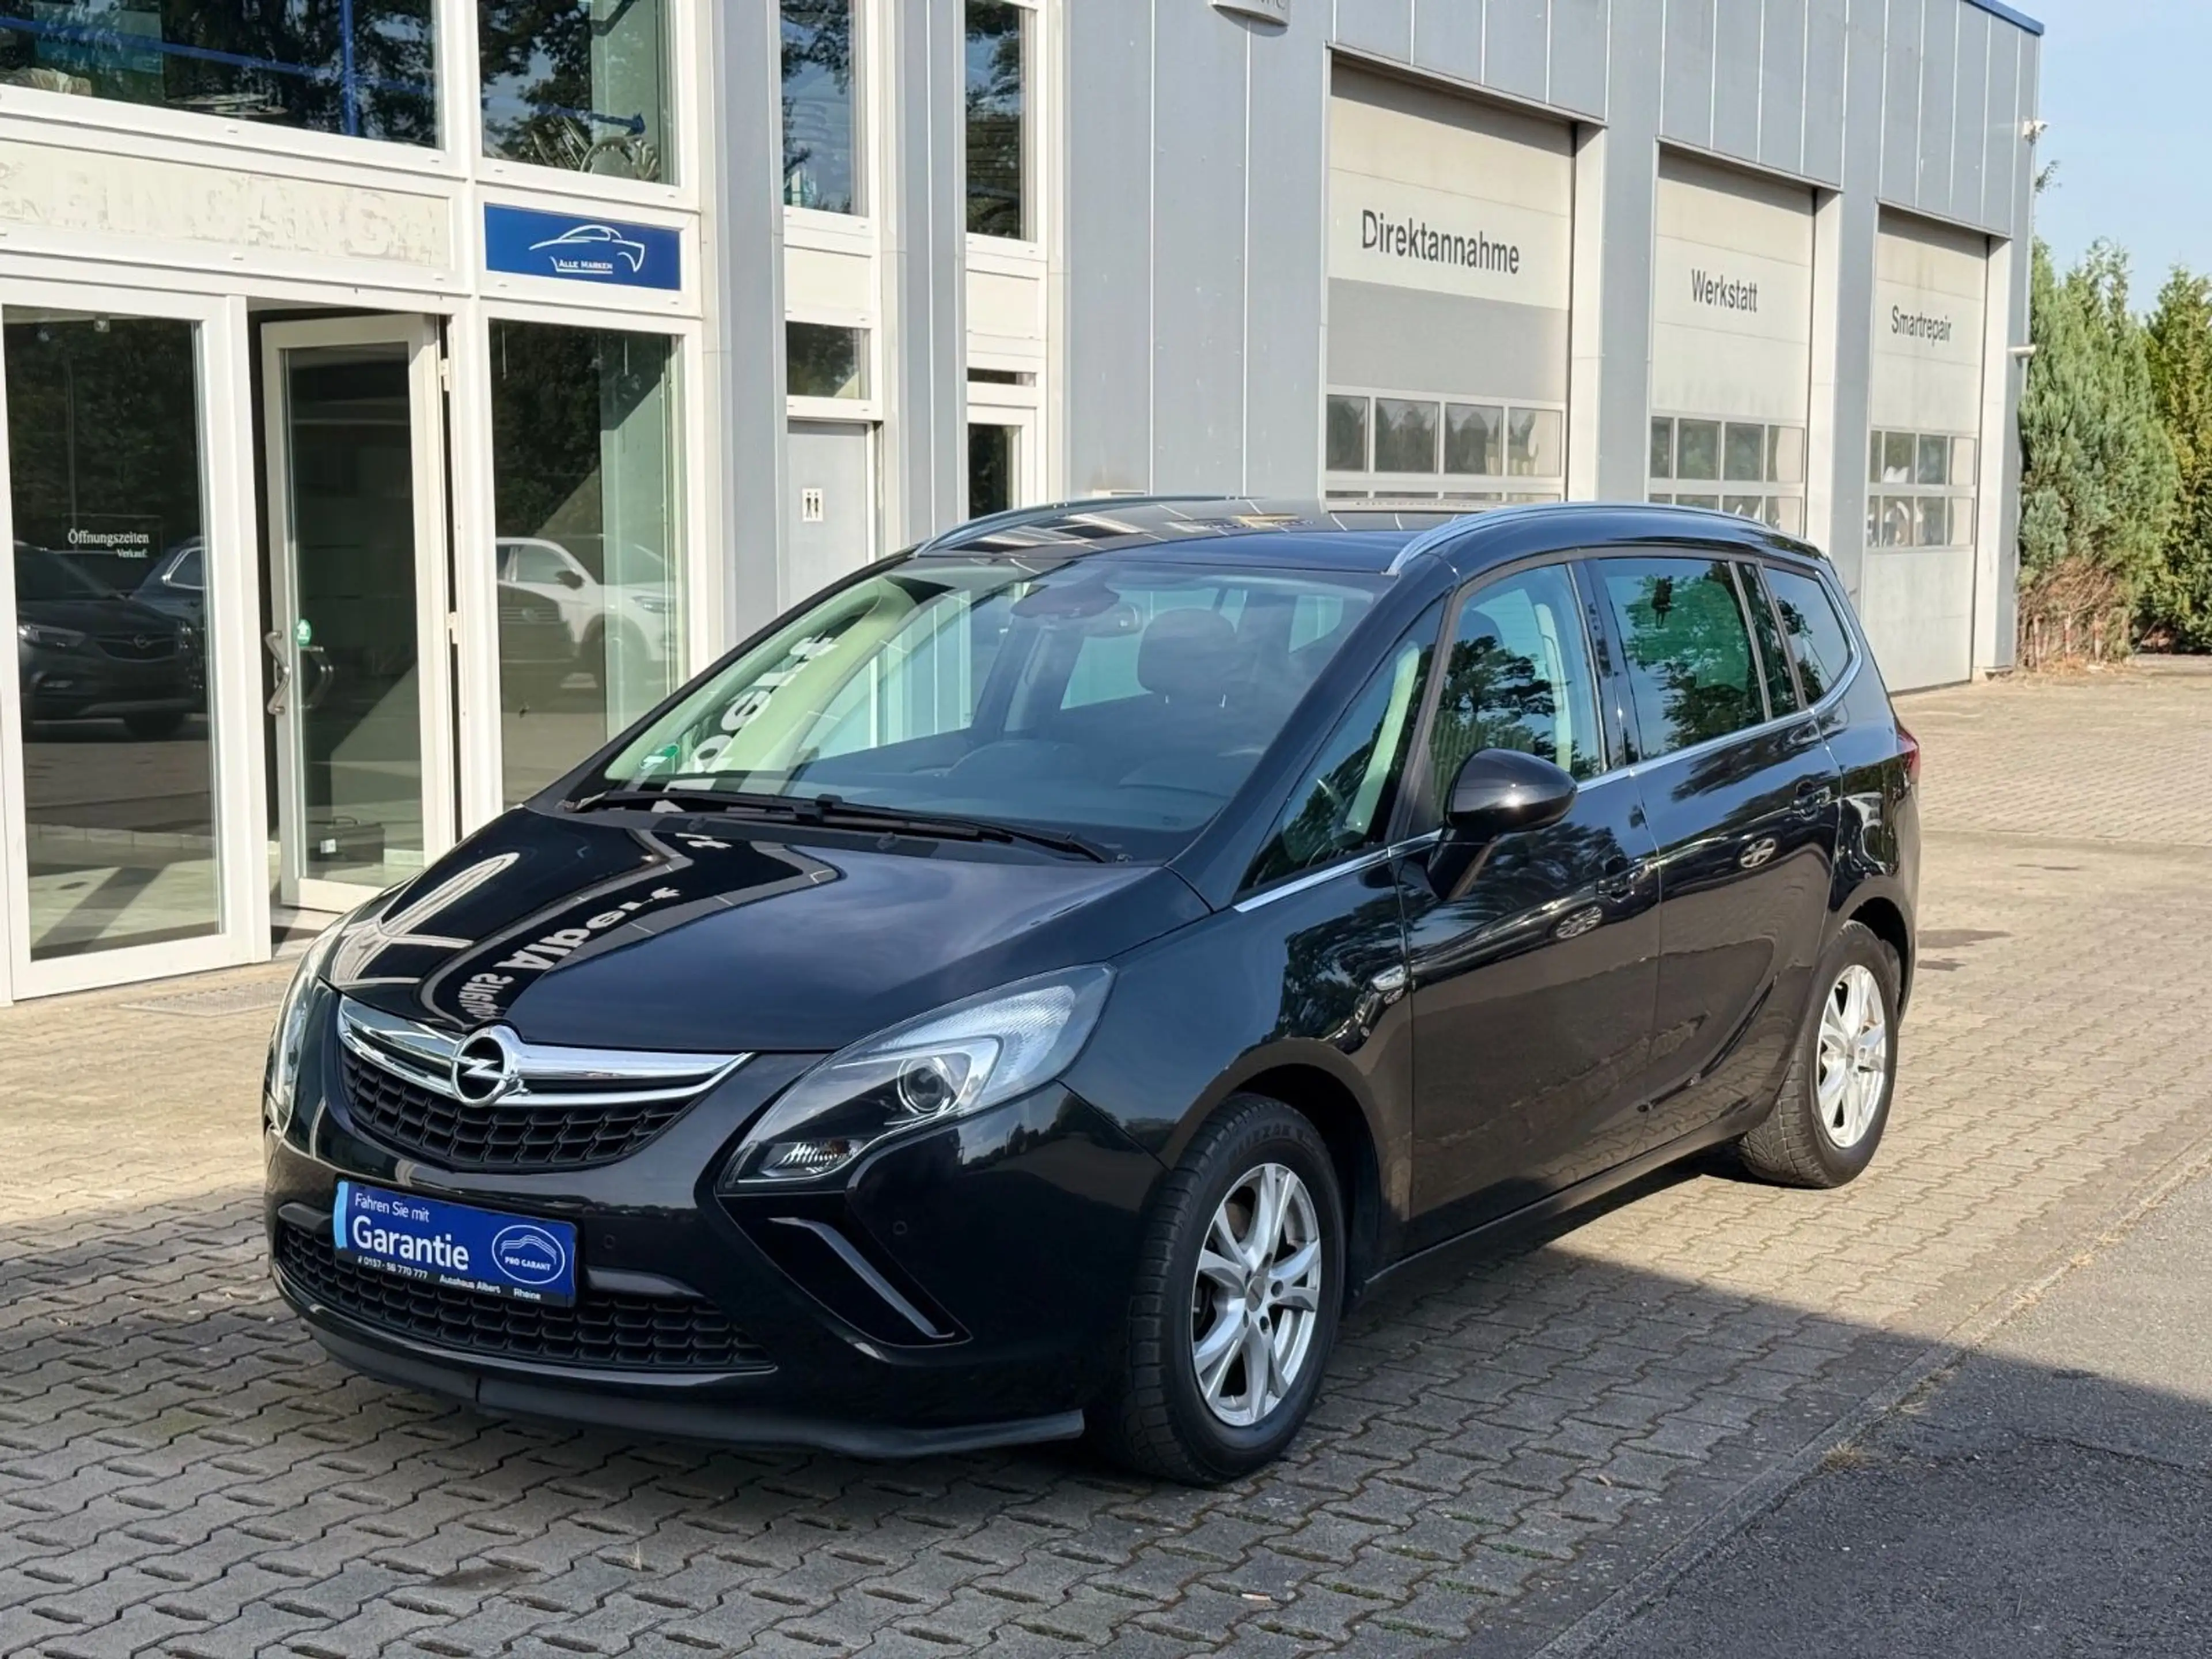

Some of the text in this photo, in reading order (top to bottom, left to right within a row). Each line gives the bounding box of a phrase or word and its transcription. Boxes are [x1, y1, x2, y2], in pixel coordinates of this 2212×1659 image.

[1362, 209, 1520, 274] Direktannahme
[558, 259, 613, 270] ALLE MARKEN
[1691, 268, 1758, 313] Werkstatt
[1891, 305, 1952, 347] Smartrepair
[67, 528, 149, 547] Öffnungszeiten
[355, 1192, 430, 1222] Fahren Sie mit
[353, 1215, 469, 1271] Garantie
